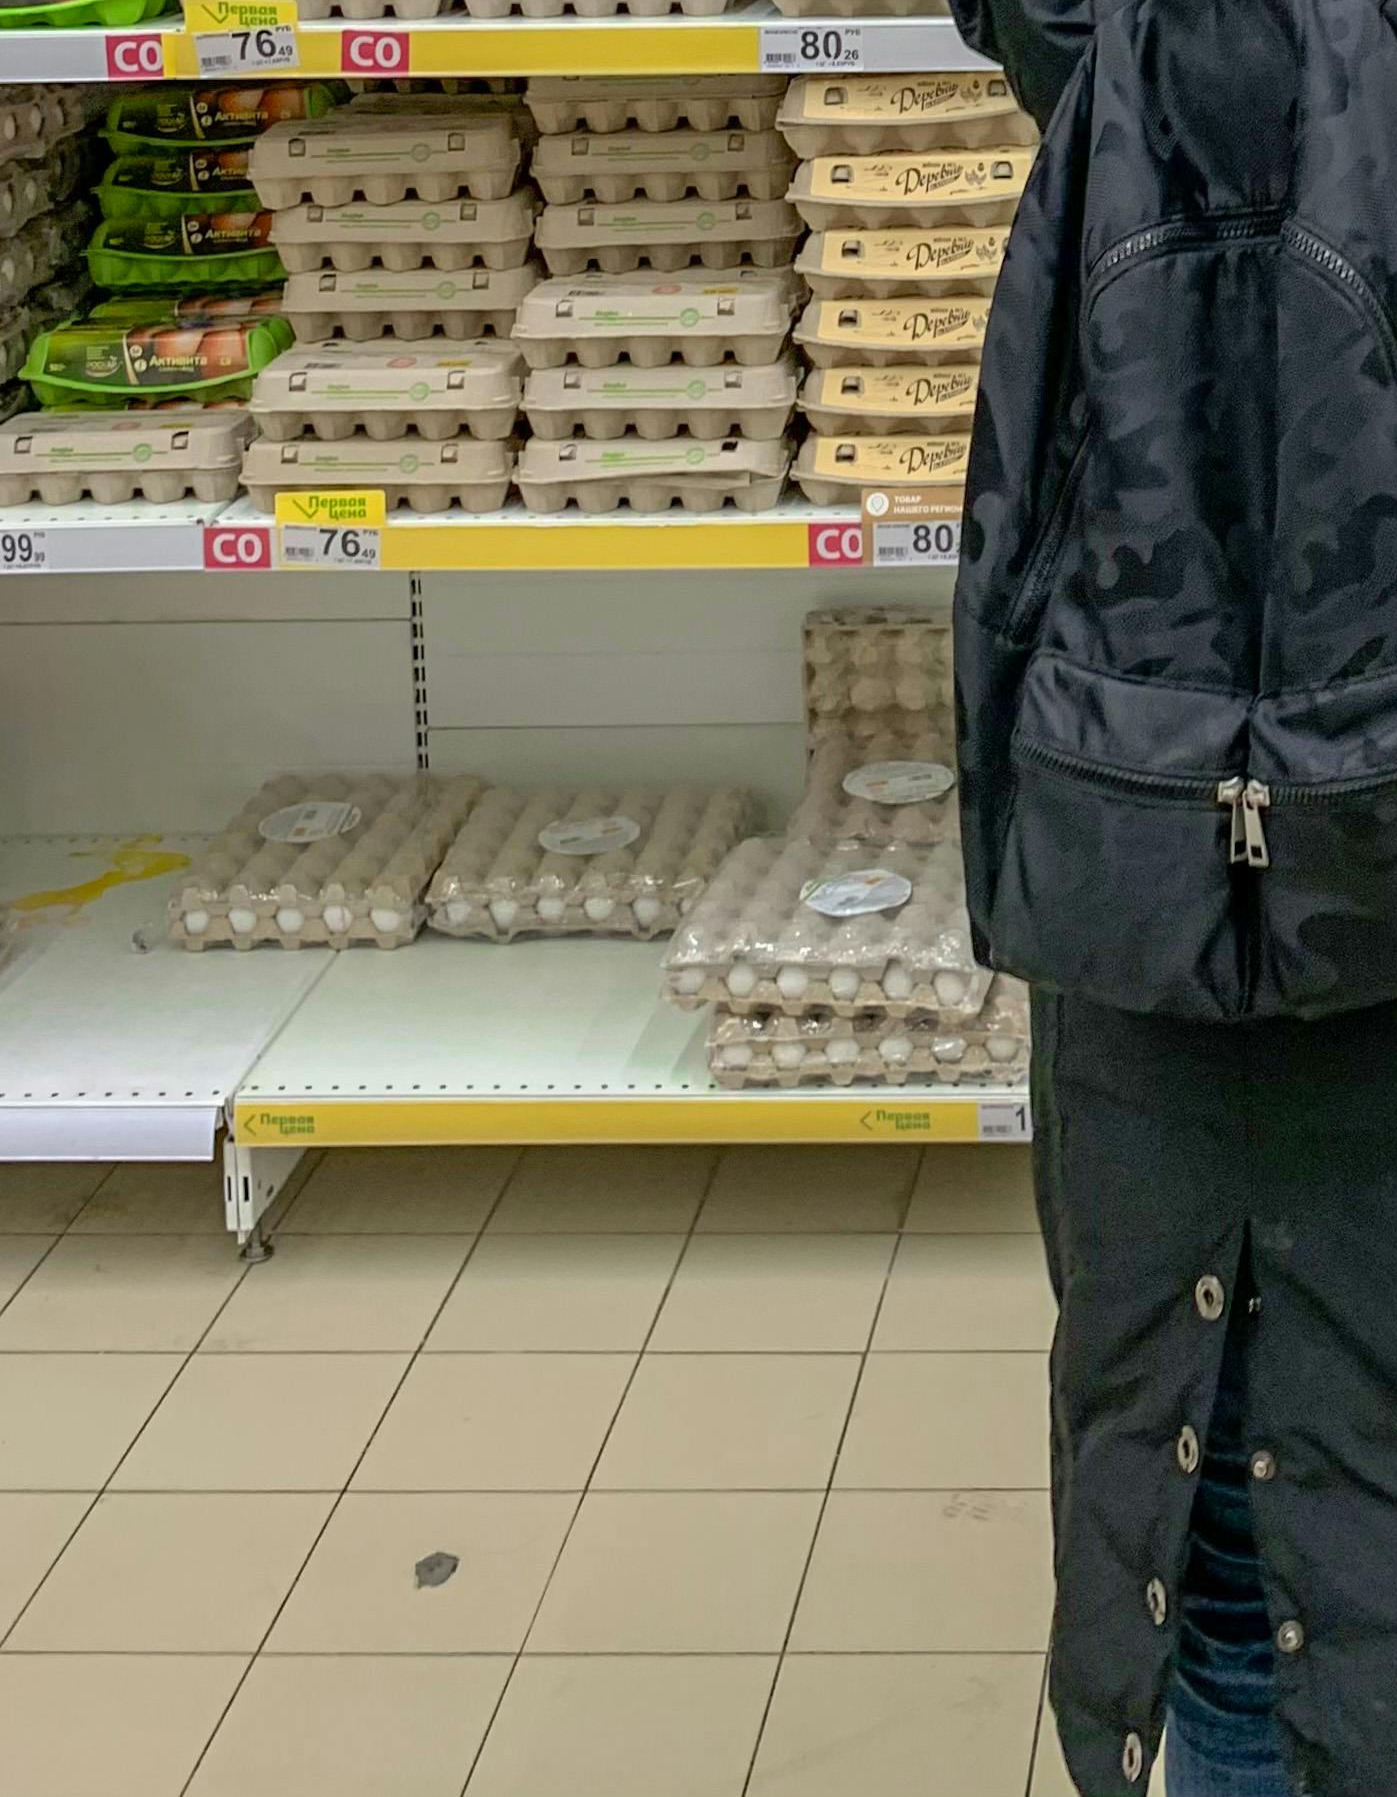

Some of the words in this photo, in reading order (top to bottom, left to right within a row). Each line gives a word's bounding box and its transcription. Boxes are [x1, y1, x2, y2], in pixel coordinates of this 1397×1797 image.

[218, 2, 277, 15] Первая
[232, 30, 276, 60] 76
[278, 46, 293, 56] 49
[801, 31, 841, 59] 80
[844, 50, 859, 60] 26
[309, 496, 366, 509] Первая
[2, 534, 32, 562] 99
[318, 529, 360, 556] 76
[361, 549, 375, 560] 49
[912, 525, 953, 553] 80
